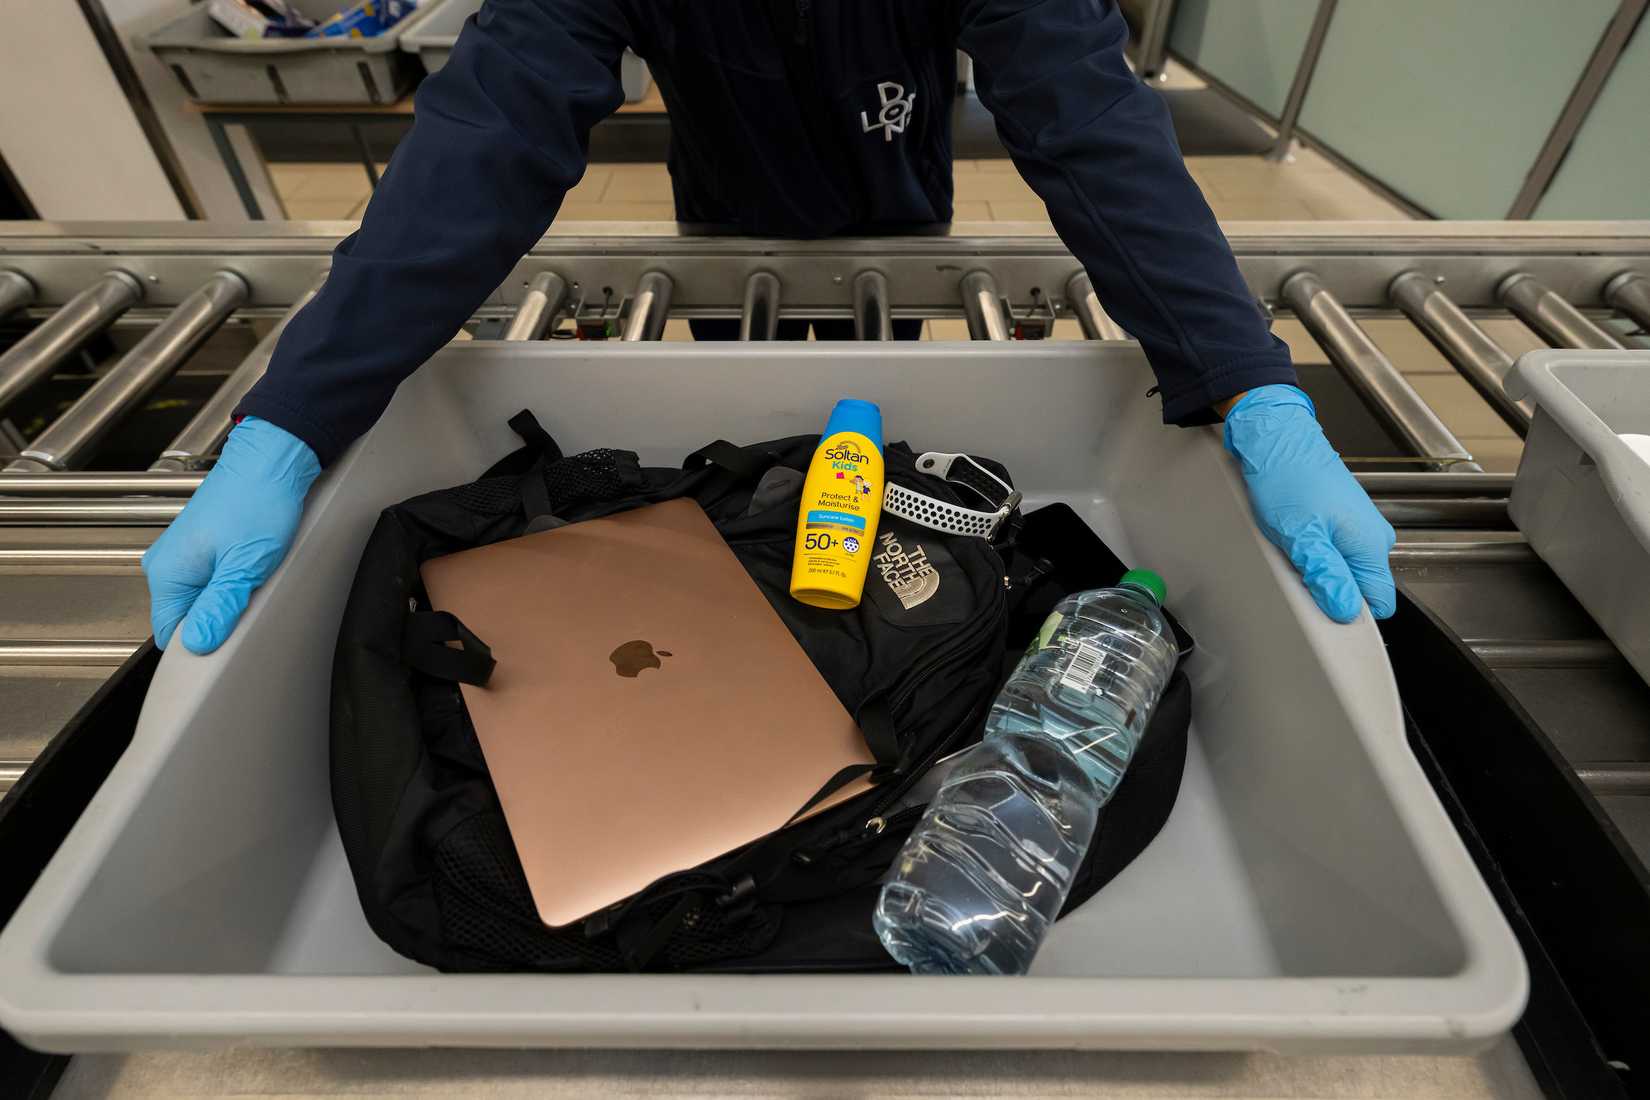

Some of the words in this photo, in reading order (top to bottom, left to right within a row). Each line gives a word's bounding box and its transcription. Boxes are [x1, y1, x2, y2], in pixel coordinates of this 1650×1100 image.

[824, 448, 869, 465] Soltan
[832, 461, 858, 471] Kids
[818, 499, 861, 511] Moisturise
[821, 492, 851, 501] Protect
[804, 533, 839, 550] 50+
[879, 532, 921, 584] NORTH
[907, 545, 933, 577] THE
[873, 552, 908, 588] FACE
